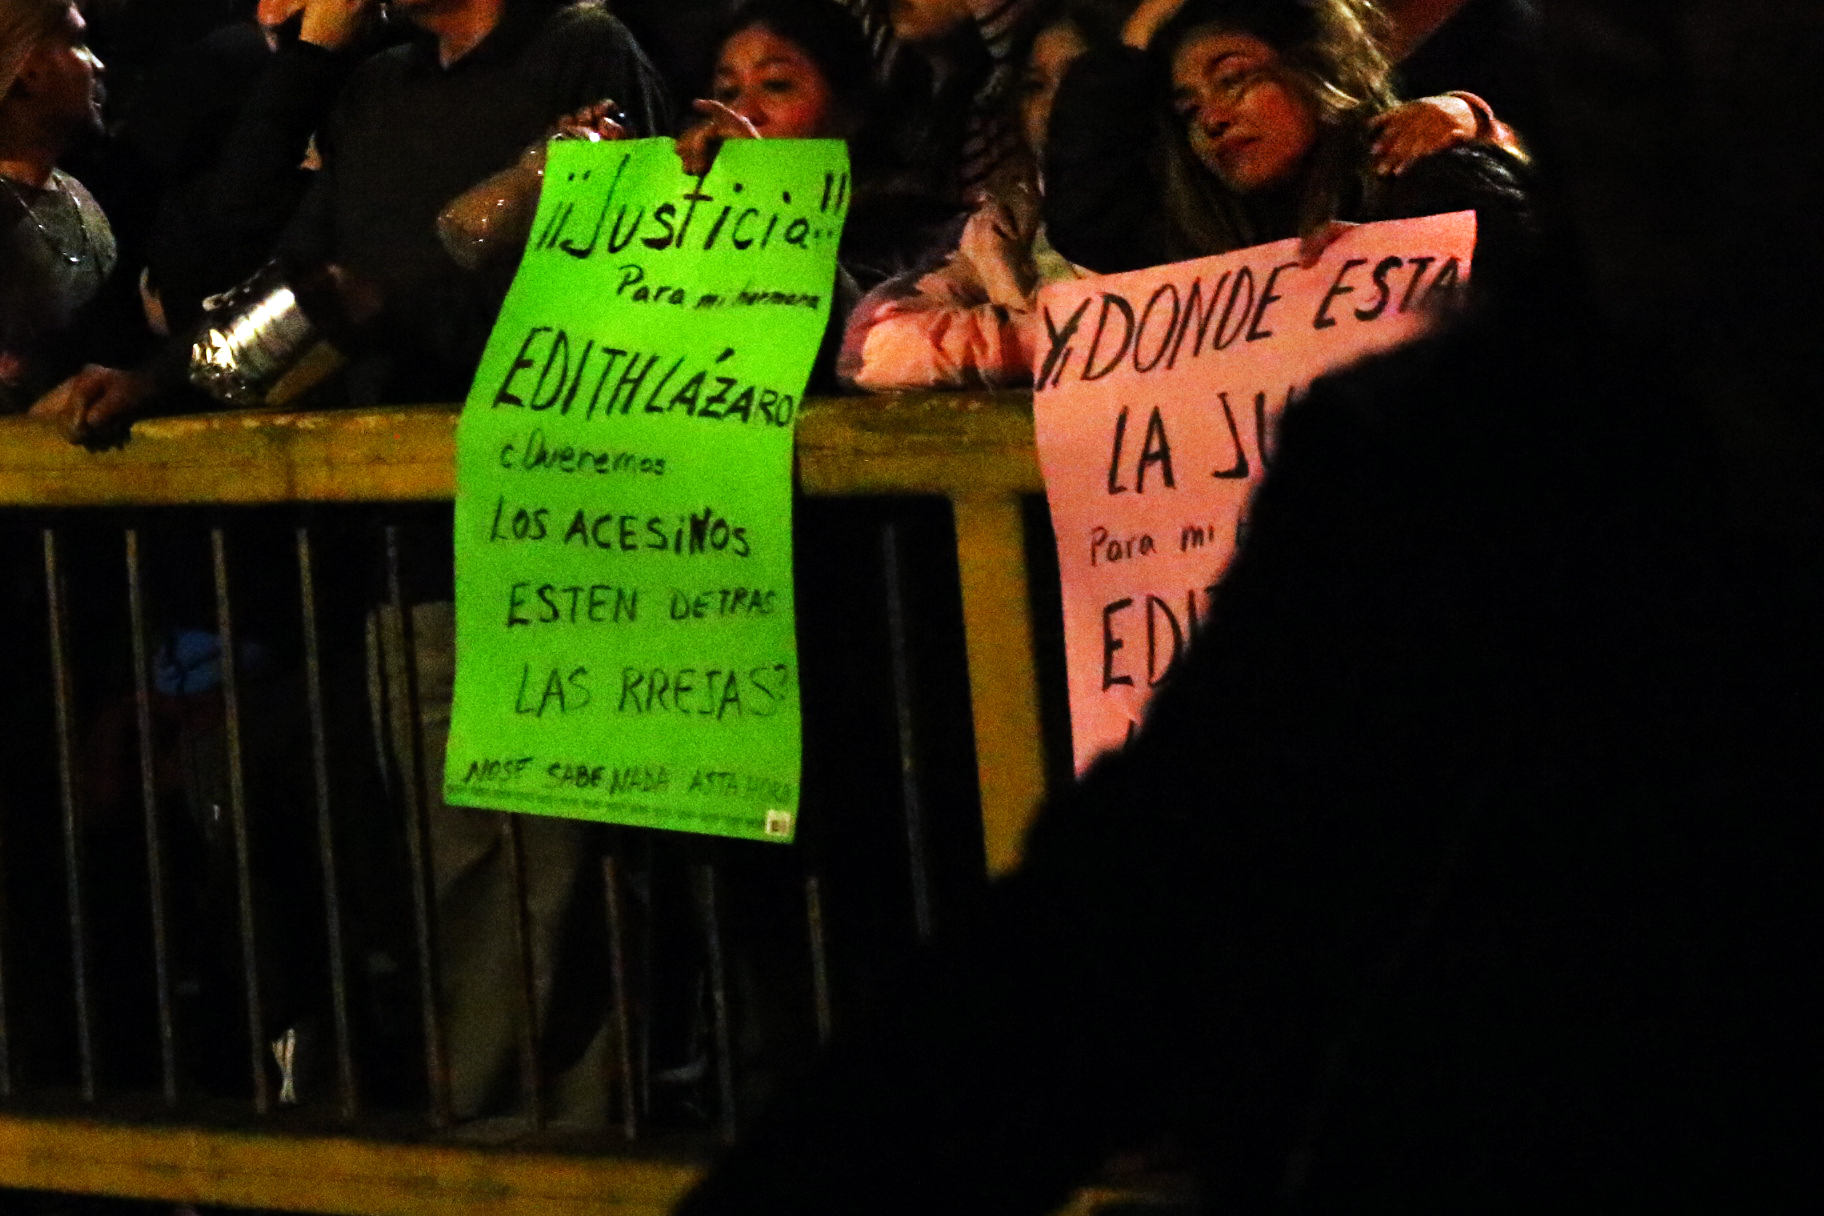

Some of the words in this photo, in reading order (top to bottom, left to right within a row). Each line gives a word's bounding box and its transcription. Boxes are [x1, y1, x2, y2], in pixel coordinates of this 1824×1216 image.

[616, 263, 685, 306] Para
[1108, 403, 1176, 495] LA
[489, 494, 550, 543] LOS
[1089, 524, 1157, 568] Para
[1179, 524, 1215, 553] mi
[506, 582, 639, 630] ESTEN
[669, 586, 777, 622] DETRAS
[513, 663, 593, 719] LAS
